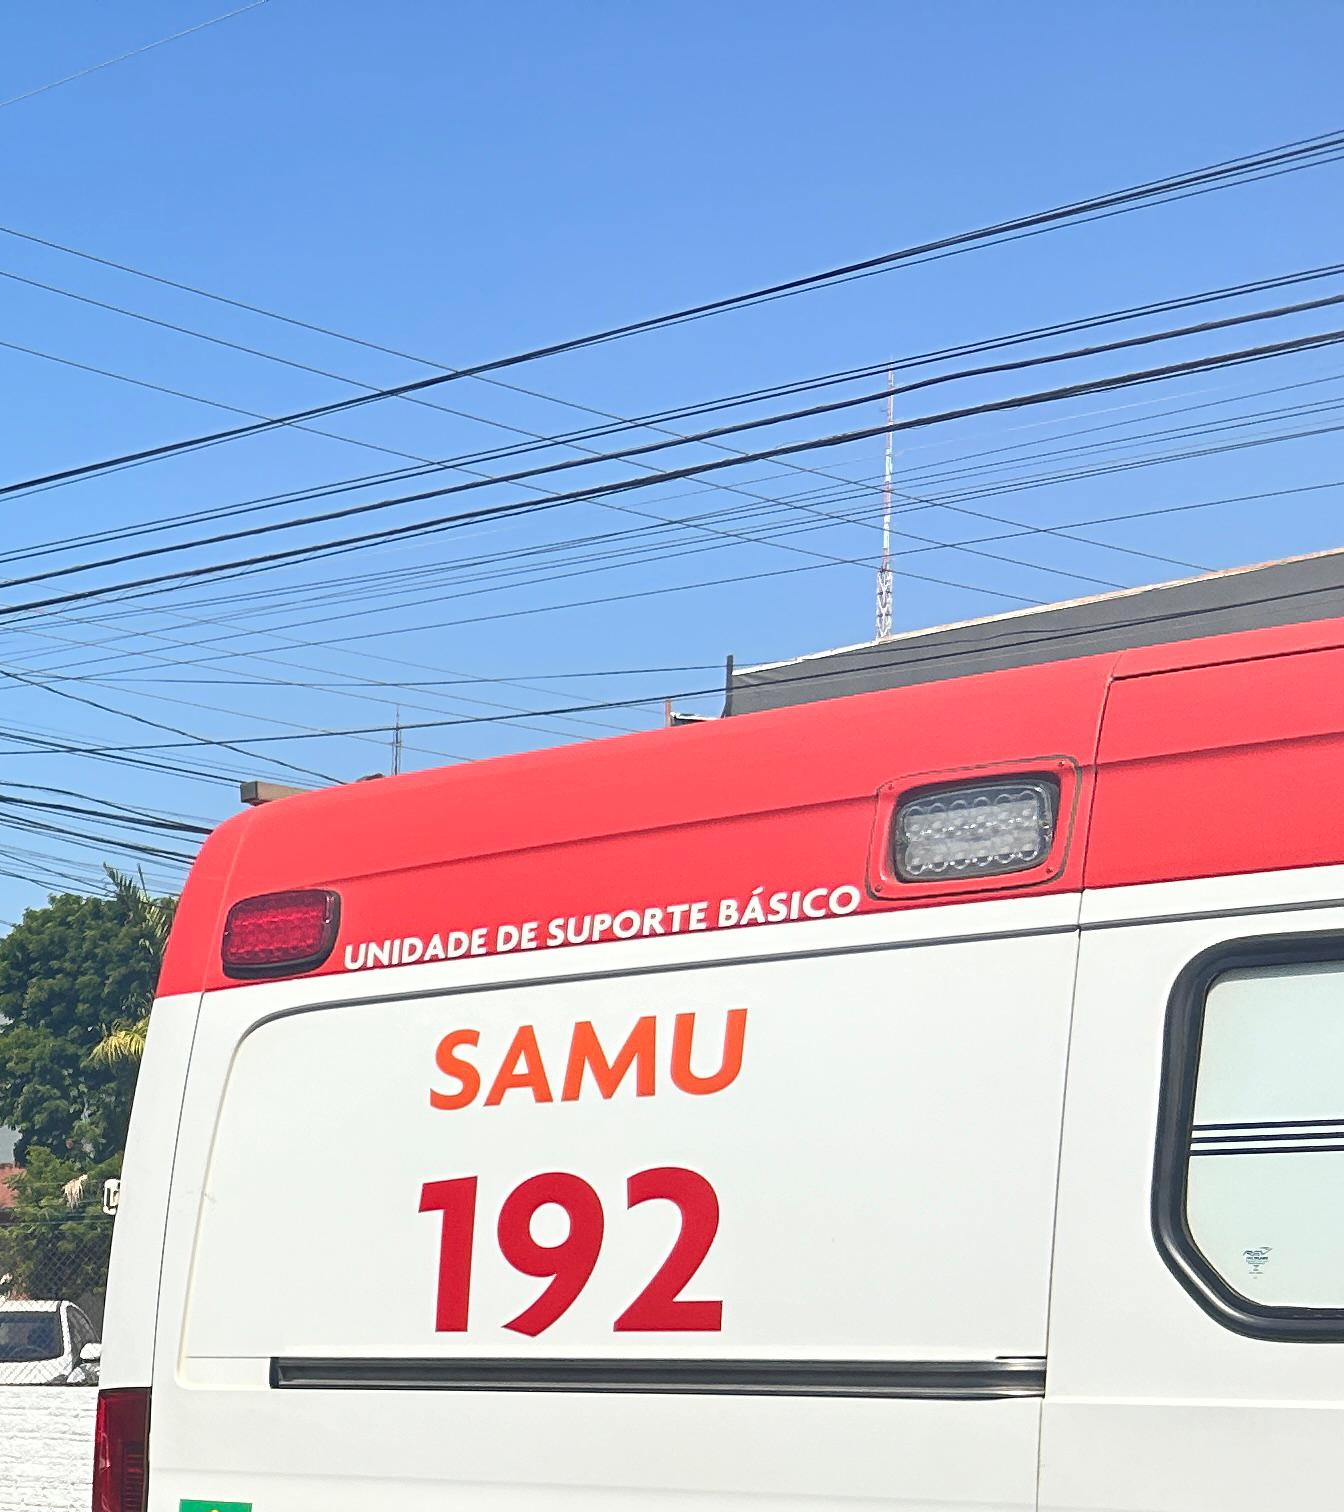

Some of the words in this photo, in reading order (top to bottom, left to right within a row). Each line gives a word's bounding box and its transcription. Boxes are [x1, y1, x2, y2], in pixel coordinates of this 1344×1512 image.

[343, 927, 489, 971] UNIDADE
[496, 921, 539, 952] DE
[545, 901, 709, 947] SUPORTE
[717, 885, 862, 928] BÁSICO
[429, 1008, 747, 1111] SAMU
[419, 1167, 723, 1337] 192
